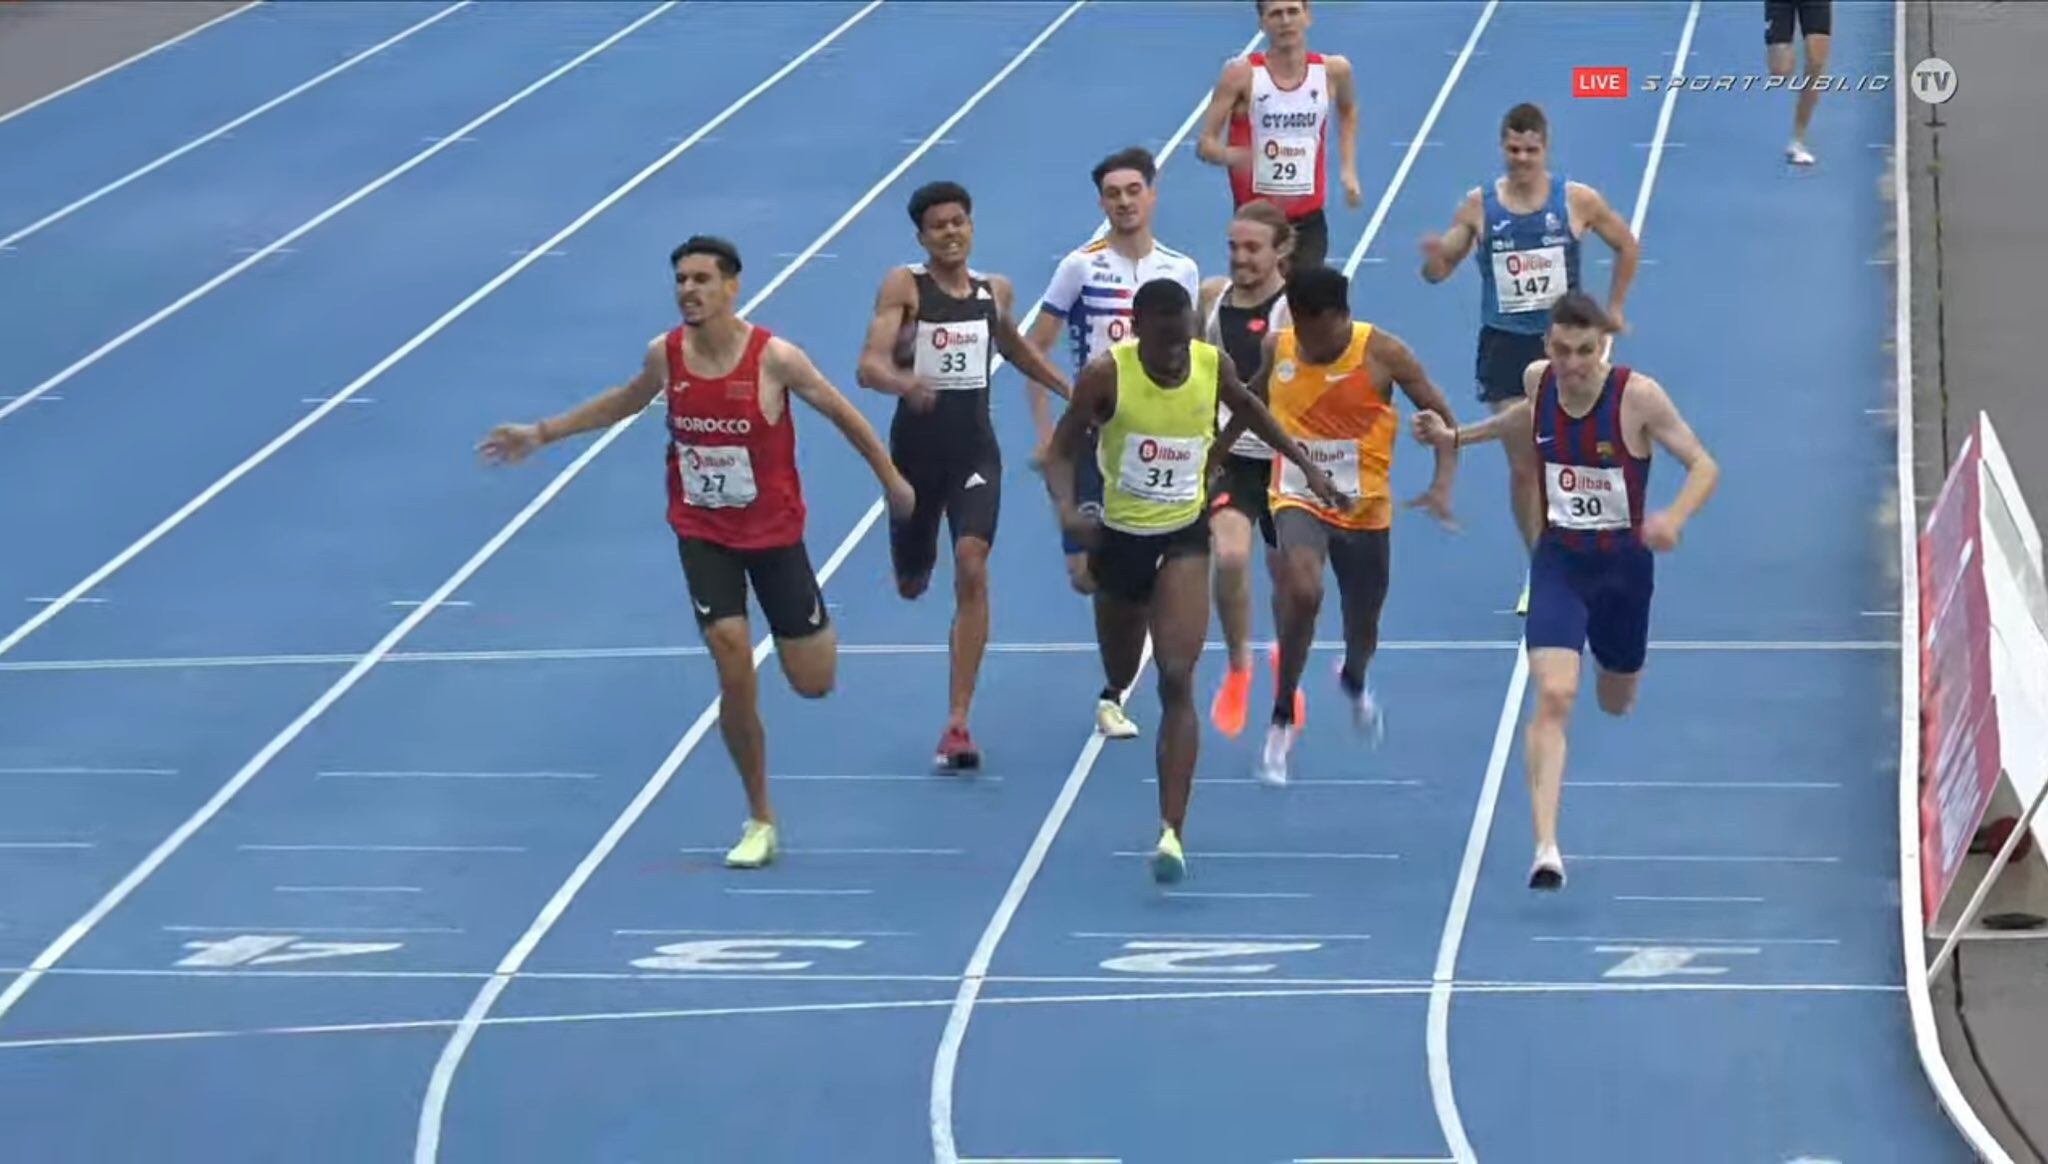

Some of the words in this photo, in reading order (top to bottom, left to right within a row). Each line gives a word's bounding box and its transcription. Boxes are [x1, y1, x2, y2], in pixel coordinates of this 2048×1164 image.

[1262, 112, 1317, 128] CYMRU
[1272, 162, 1297, 180] 29
[1512, 276, 1550, 297] 147
[940, 352, 967, 373] 33
[674, 417, 751, 433] MOROCCO
[1139, 439, 1191, 463] Bilbao
[700, 474, 727, 493] 27
[1144, 467, 1174, 488] 31
[1559, 468, 1612, 492] Bilbao
[1571, 496, 1602, 517] 30
[629, 939, 865, 971] 3
[1100, 941, 1322, 973] 2
